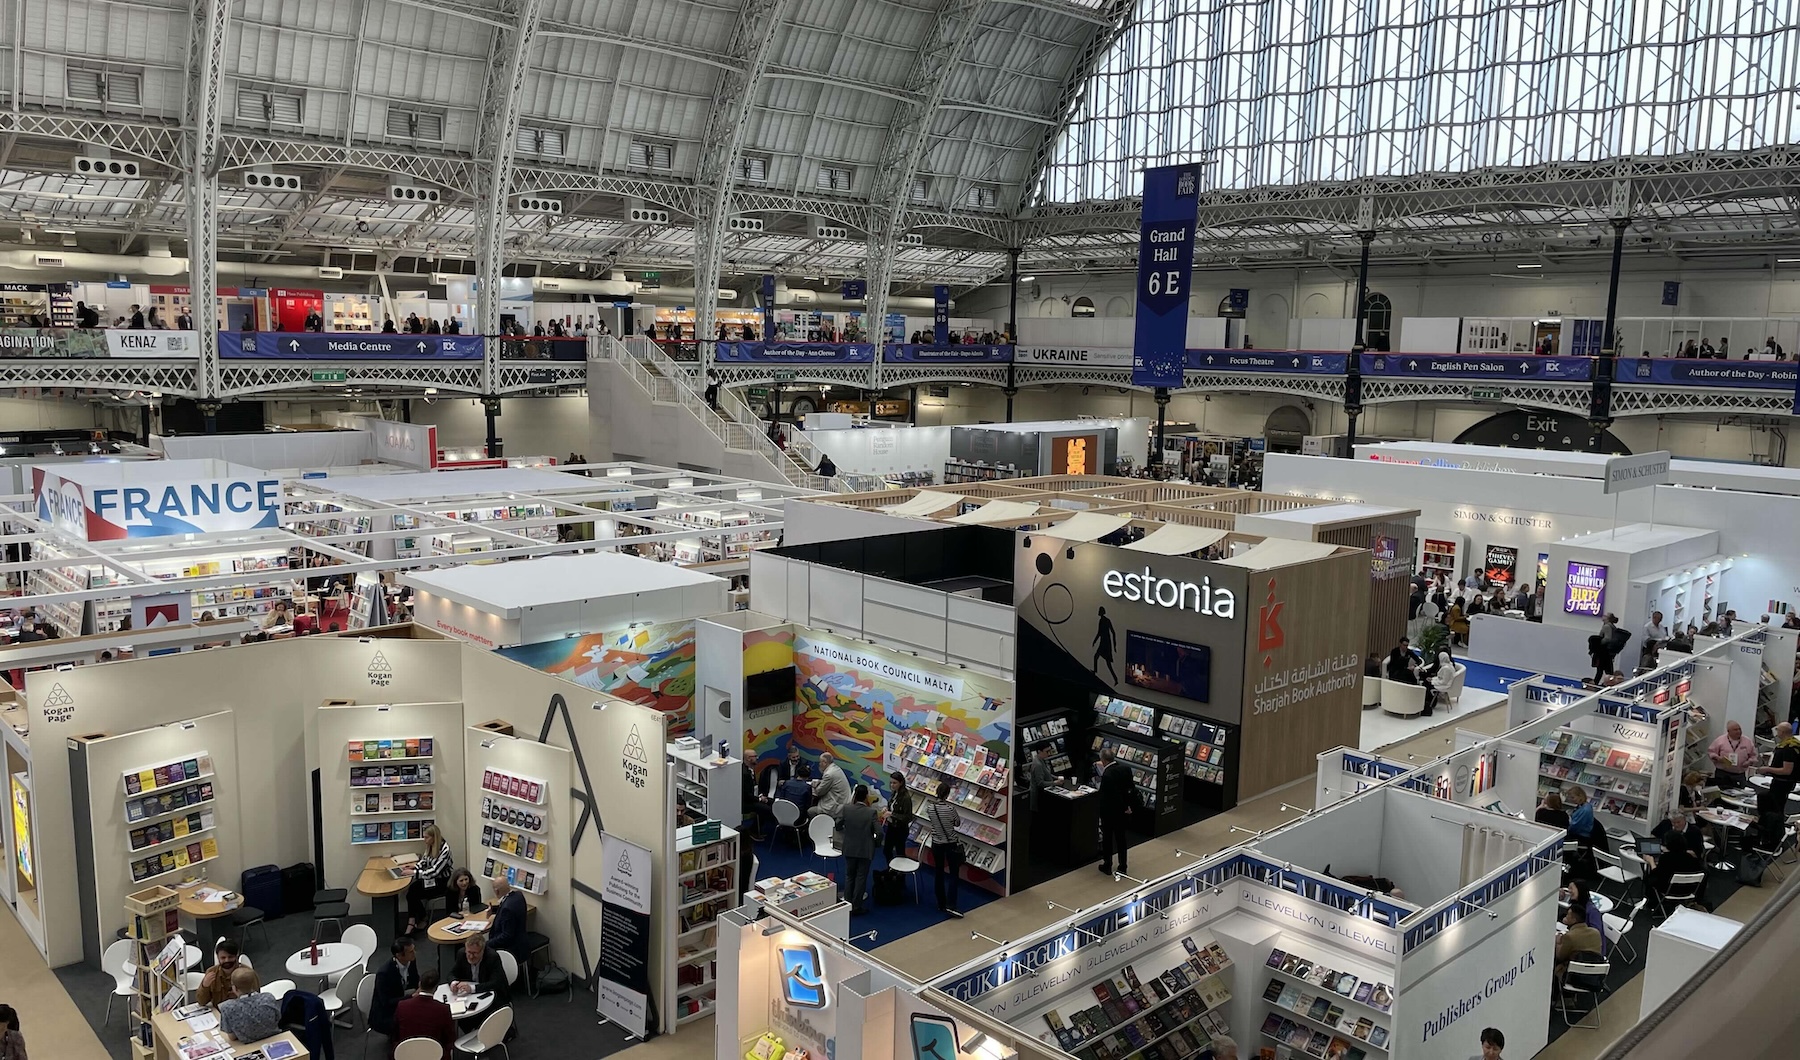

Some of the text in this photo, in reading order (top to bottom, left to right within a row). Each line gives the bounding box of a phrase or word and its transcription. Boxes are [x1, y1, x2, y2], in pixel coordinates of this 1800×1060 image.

[1177, 186, 1194, 195] FAIR
[1178, 180, 1195, 189] BOOK
[1150, 227, 1185, 243] Grand
[1153, 248, 1177, 262] Hall
[120, 335, 157, 348] KENAZ
[328, 341, 392, 351] Media Centre
[1033, 348, 1088, 361] UKRAINE
[1229, 356, 1275, 365] Focus Theatre
[1431, 361, 1504, 373] English Pen Salon
[1689, 368, 1719, 376] Author
[1720, 369, 1732, 377] of
[1732, 370, 1746, 378] the
[1747, 371, 1765, 380] Day
[1771, 371, 1798, 380] Robin
[1526, 415, 1559, 433] Exit
[1612, 461, 1667, 482] SIMON & SCHUSTER
[93, 479, 281, 521] FRANCE
[48, 488, 83, 528] FRANCE
[1453, 510, 1552, 529] SIMON & SCHUSTER
[1488, 552, 1515, 560] THIEVES
[1488, 557, 1512, 566] GAMBIT
[1576, 566, 1598, 577] JANET
[1568, 574, 1605, 588] EVANOVICH
[1103, 565, 1235, 619] estonia
[1571, 588, 1600, 601] DIRTY
[1565, 600, 1601, 615] Thirty
[437, 620, 493, 647] Every book matters
[1740, 646, 1762, 655] 6E30
[814, 645, 954, 693] NATIONAL BOOK COUNCIL MALTA
[1254, 653, 1359, 698] هيئة الشارقة للكتاب
[367, 672, 392, 682] Kogan
[370, 678, 390, 686] Page
[1253, 672, 1358, 715] Sharjah Book Authority
[43, 706, 75, 716] Kogan
[47, 714, 72, 723] Page
[749, 703, 788, 720] GUTENBERG
[622, 758, 648, 777] Kogan
[625, 771, 645, 788] Page
[799, 900, 825, 912] NATIONAL
[1251, 894, 1325, 929] LLEWELLYN
[1159, 904, 1209, 935] LLEWELLYN
[1026, 934, 1072, 969] PGUK
[1094, 932, 1149, 967] LLEWELLYN
[1021, 965, 1082, 1002] LLEWELLYN
[1422, 947, 1536, 1043] Publishers Group UK
